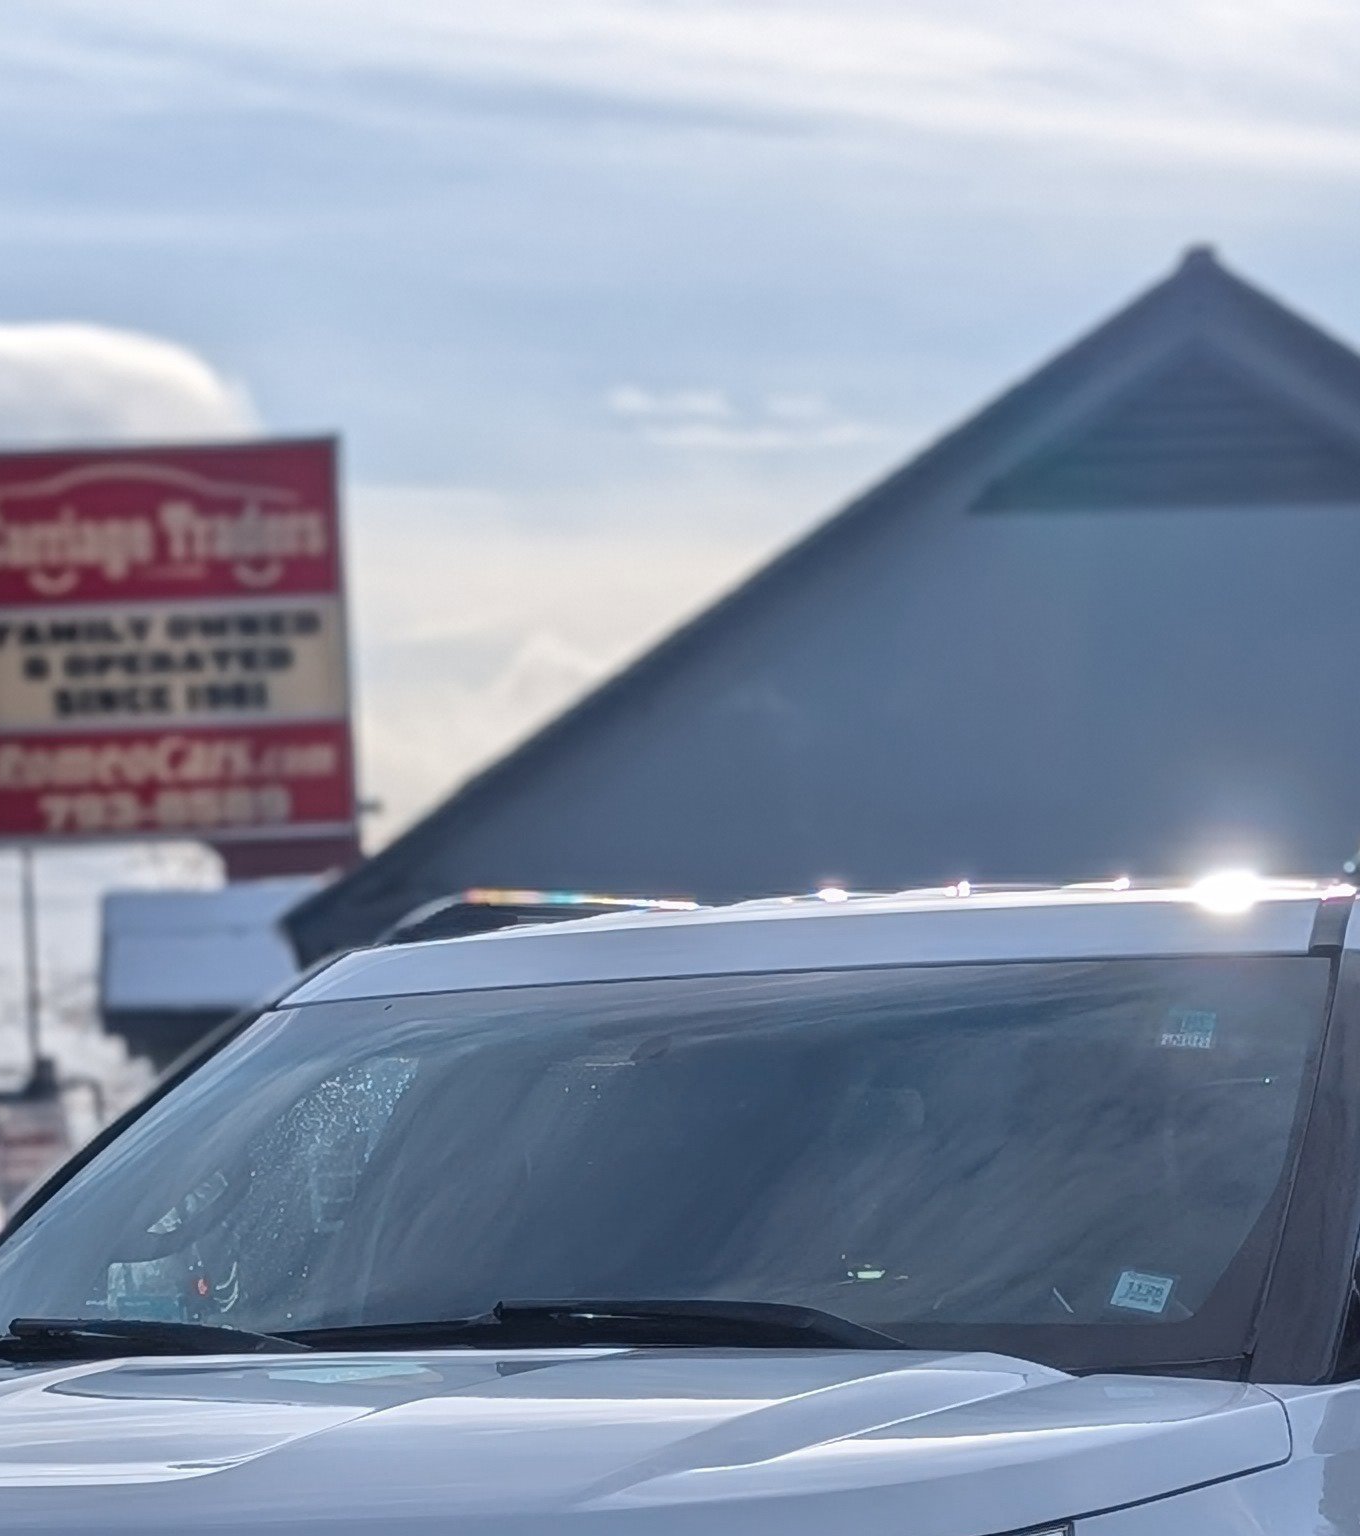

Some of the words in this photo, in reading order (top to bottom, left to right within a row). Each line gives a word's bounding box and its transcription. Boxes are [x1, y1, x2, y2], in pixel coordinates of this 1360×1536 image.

[158, 500, 328, 560] Traders
[165, 610, 322, 641] OWNED
[63, 646, 295, 678] OPERATED
[53, 685, 171, 719] SINCE
